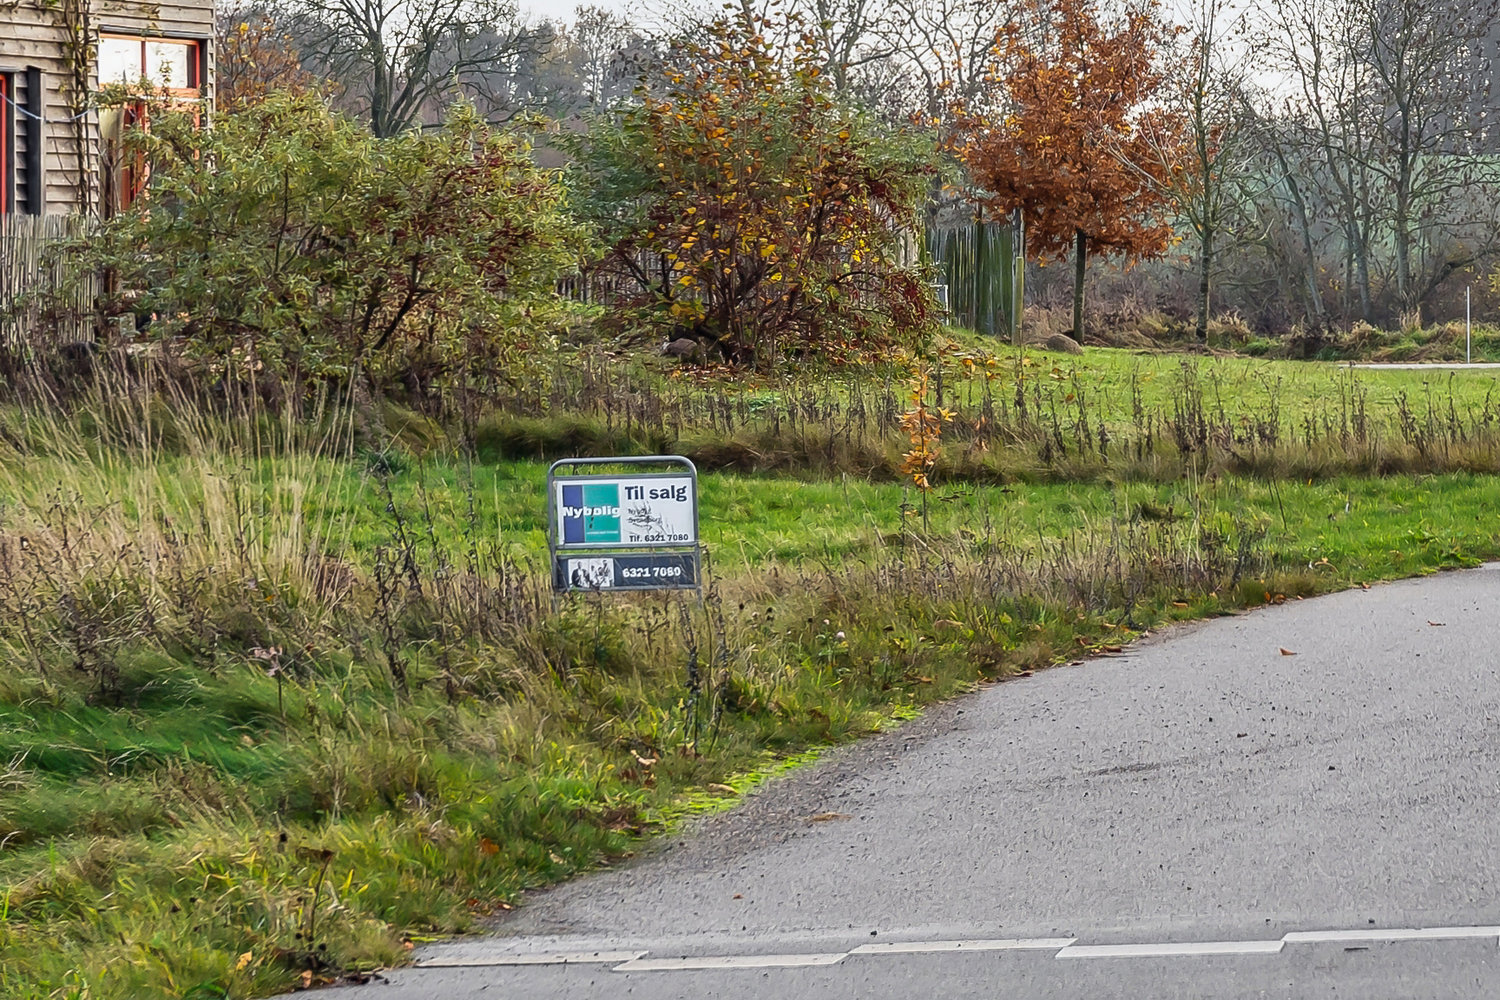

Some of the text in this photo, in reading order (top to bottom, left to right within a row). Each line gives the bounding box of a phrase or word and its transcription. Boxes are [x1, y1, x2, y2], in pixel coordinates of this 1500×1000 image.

[625, 485, 687, 502] Til salg
[563, 506, 621, 518] Nybolig
[645, 534, 665, 542] 6321
[622, 567, 651, 578] 6321
